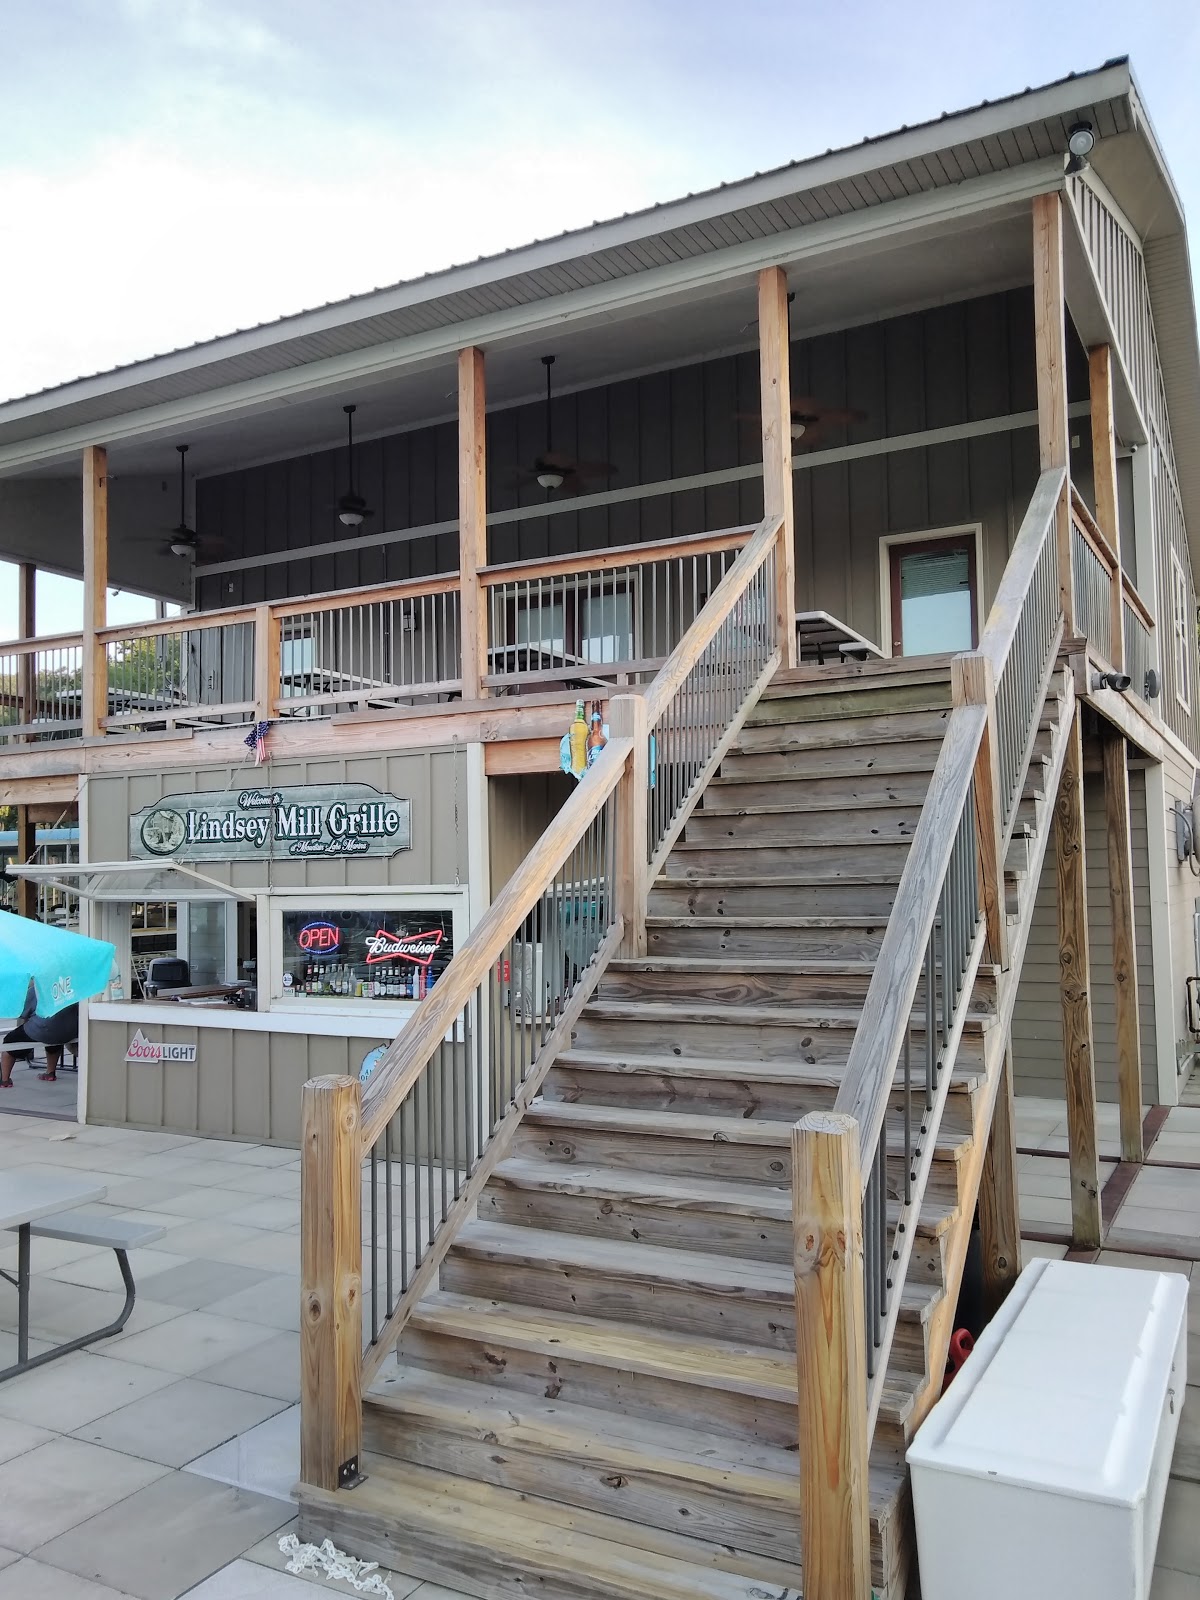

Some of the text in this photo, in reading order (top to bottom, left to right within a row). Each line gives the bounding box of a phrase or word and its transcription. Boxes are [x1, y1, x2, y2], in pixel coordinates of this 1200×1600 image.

[188, 804, 399, 845] Lindsey Mill Grille
[296, 840, 324, 853] Mountain
[325, 840, 341, 853] Lake
[342, 838, 367, 851] Marina
[300, 927, 339, 948] OPEN
[365, 936, 440, 955] Budweiser
[51, 976, 74, 1001] ONE
[128, 1039, 196, 1060] Coors LIGHT
